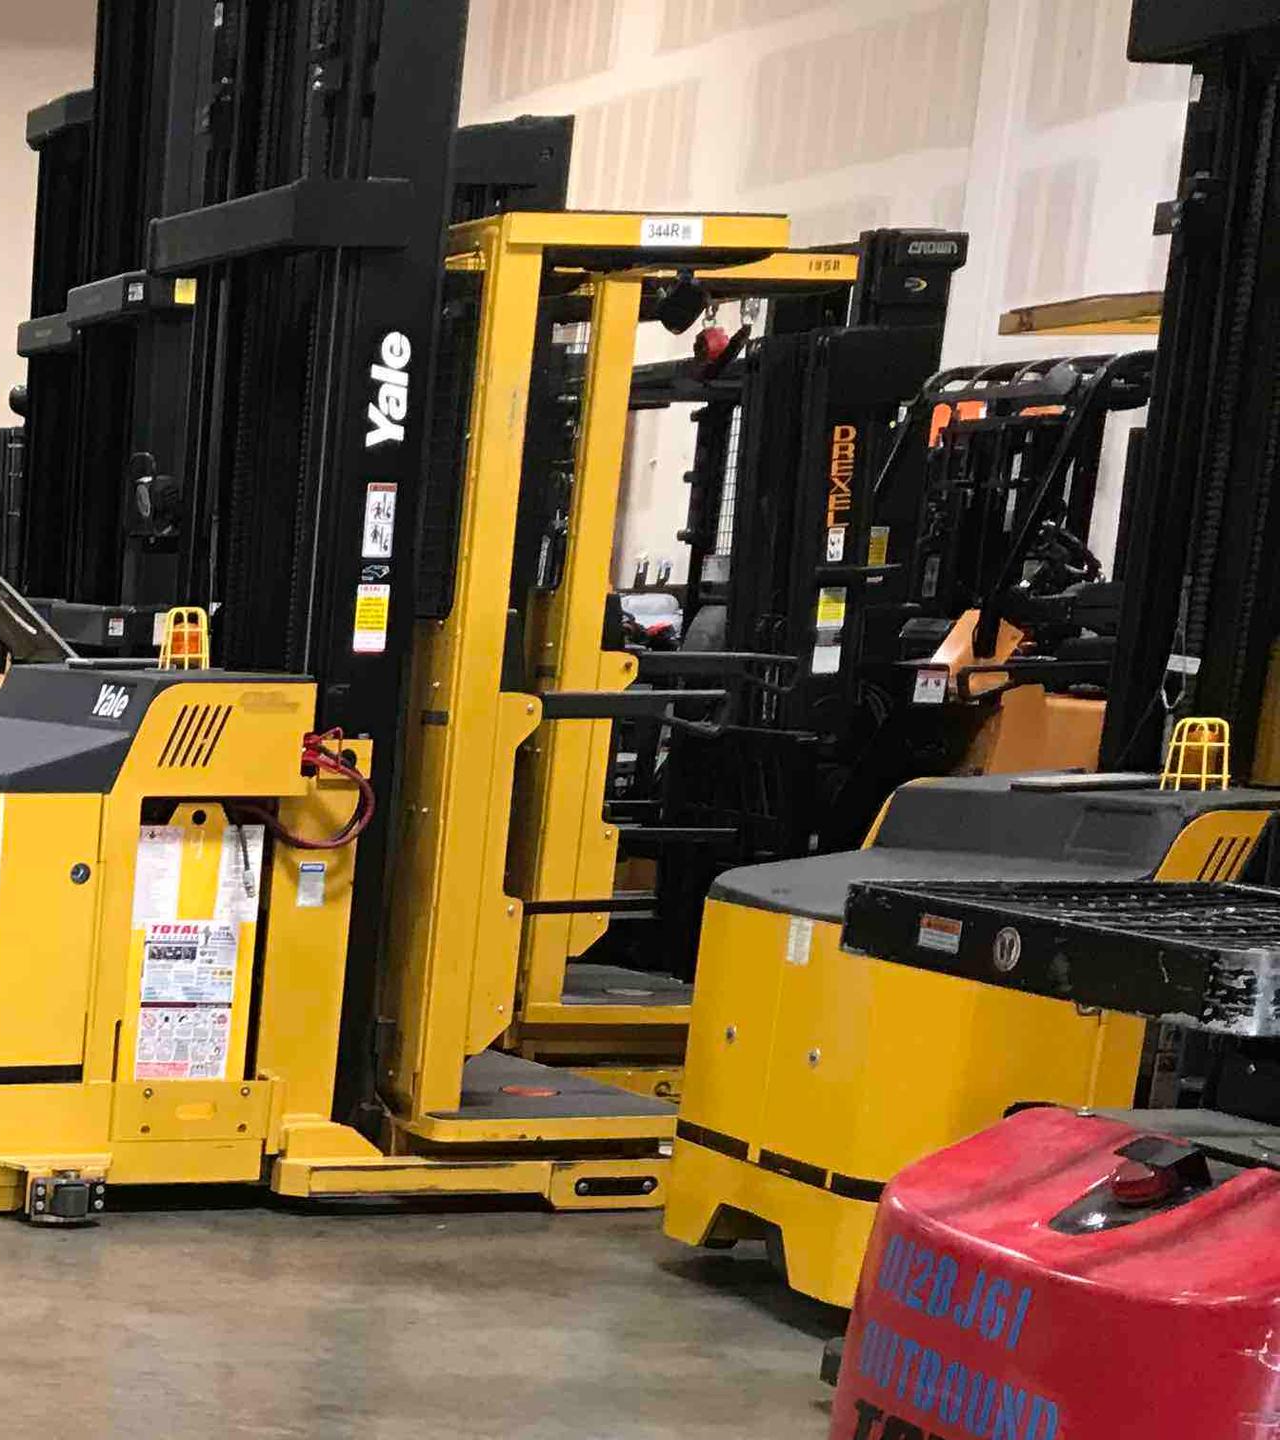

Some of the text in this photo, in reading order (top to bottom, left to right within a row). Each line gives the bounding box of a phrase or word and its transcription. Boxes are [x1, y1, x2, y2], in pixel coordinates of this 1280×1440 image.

[907, 240, 958, 255] CROWN
[365, 331, 411, 448] Yale
[826, 424, 857, 529] DREXEL
[91, 683, 130, 718] Yale
[151, 924, 199, 935] TOTAL
